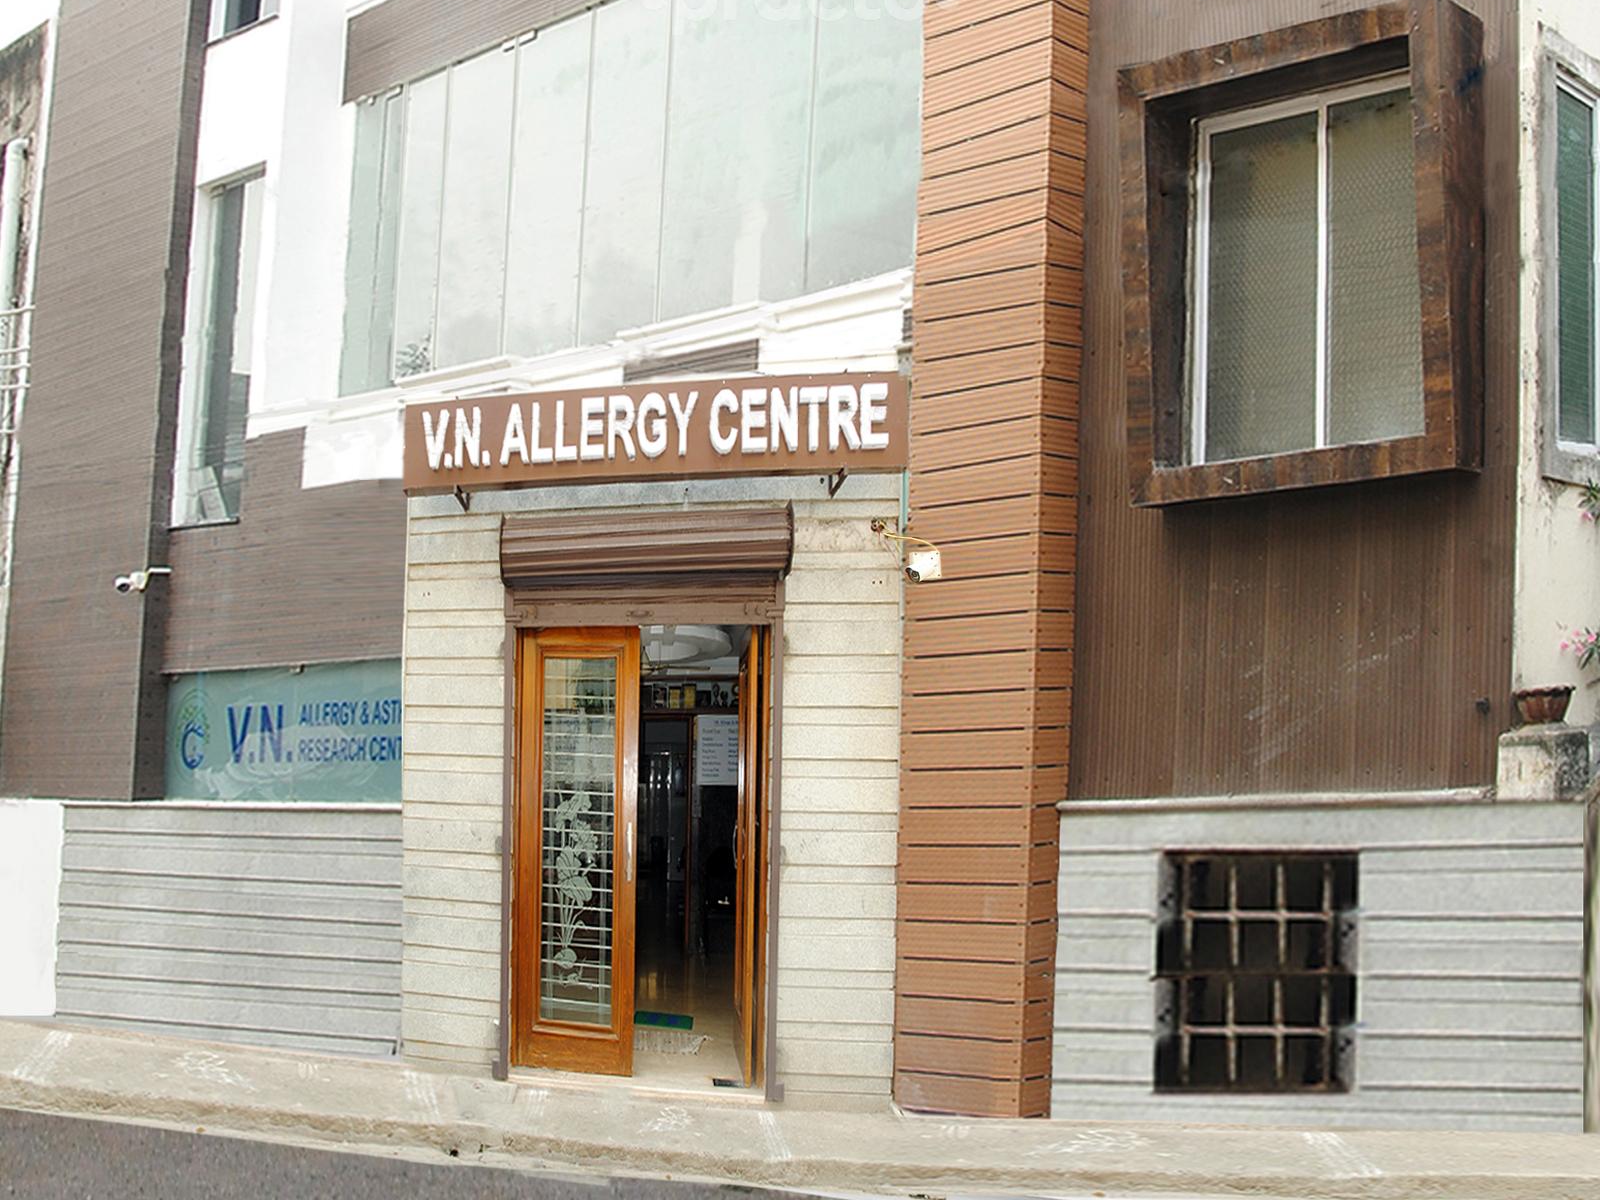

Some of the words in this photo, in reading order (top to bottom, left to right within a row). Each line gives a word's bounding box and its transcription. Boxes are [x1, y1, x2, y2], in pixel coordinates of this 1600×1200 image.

[422, 407, 493, 471] V.N.
[500, 391, 699, 466] ALLERGY
[708, 382, 890, 456] CENTRE
[227, 704, 293, 764] V.N.
[299, 701, 358, 726] ALLERGY
[360, 700, 370, 725] &
[298, 736, 367, 762] RESEARCH
